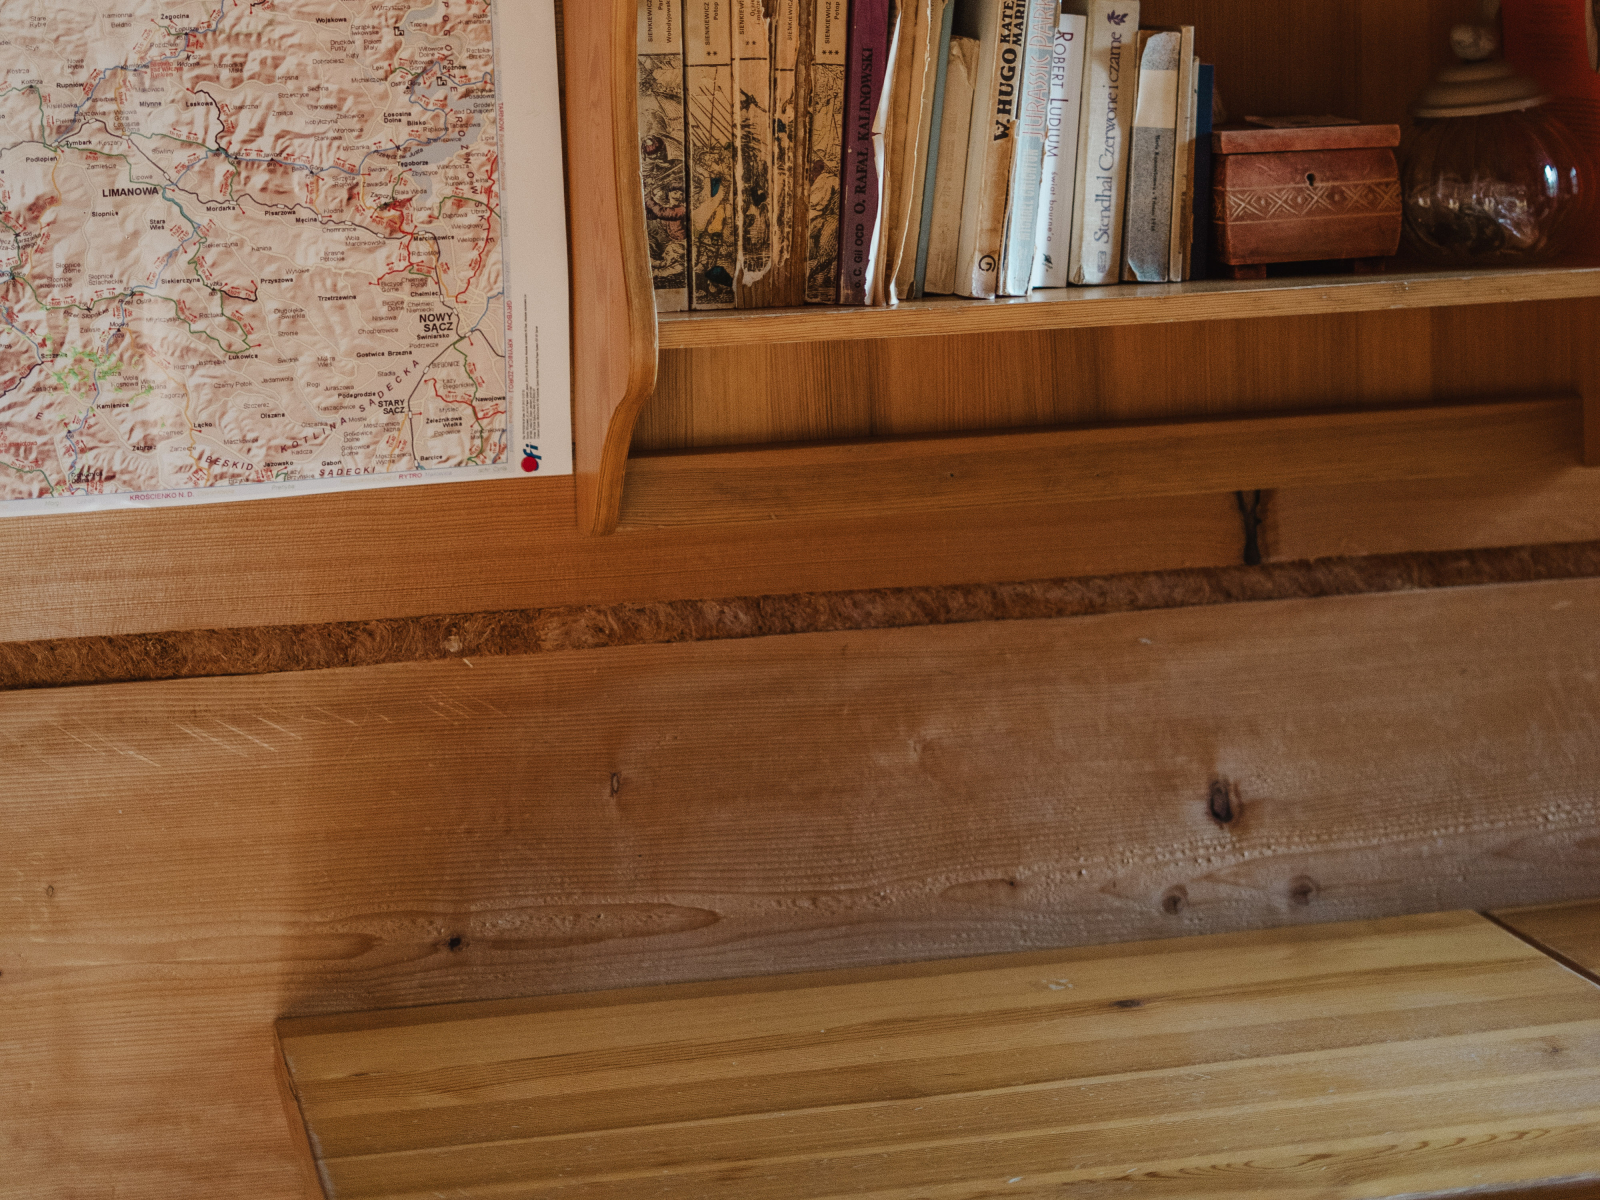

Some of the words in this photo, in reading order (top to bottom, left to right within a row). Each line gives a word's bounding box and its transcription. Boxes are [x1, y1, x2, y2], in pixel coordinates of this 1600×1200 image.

[646, 0, 654, 43] SIENKIEWICZ
[703, 1, 711, 46] SIENKIEWICZ
[824, 1, 832, 44] SIENKIEWICZ
[1051, 31, 1074, 89] ROBERT
[1107, 31, 1123, 83] czarne
[857, 47, 873, 142] KALINOWSKI
[1022, 54, 1050, 142] JURASSIC
[1098, 92, 1119, 172] Czerwone
[102, 187, 159, 198] LIMANOWA
[854, 147, 869, 196] RAFAŁ
[853, 198, 867, 215] O.
[1093, 175, 1113, 244] Stendhal
[854, 223, 865, 246] OCD
[419, 313, 453, 323] NOWY
[423, 322, 453, 334] SĄCZ
[377, 399, 405, 408] STARY
[383, 406, 405, 415] SĄCZ
